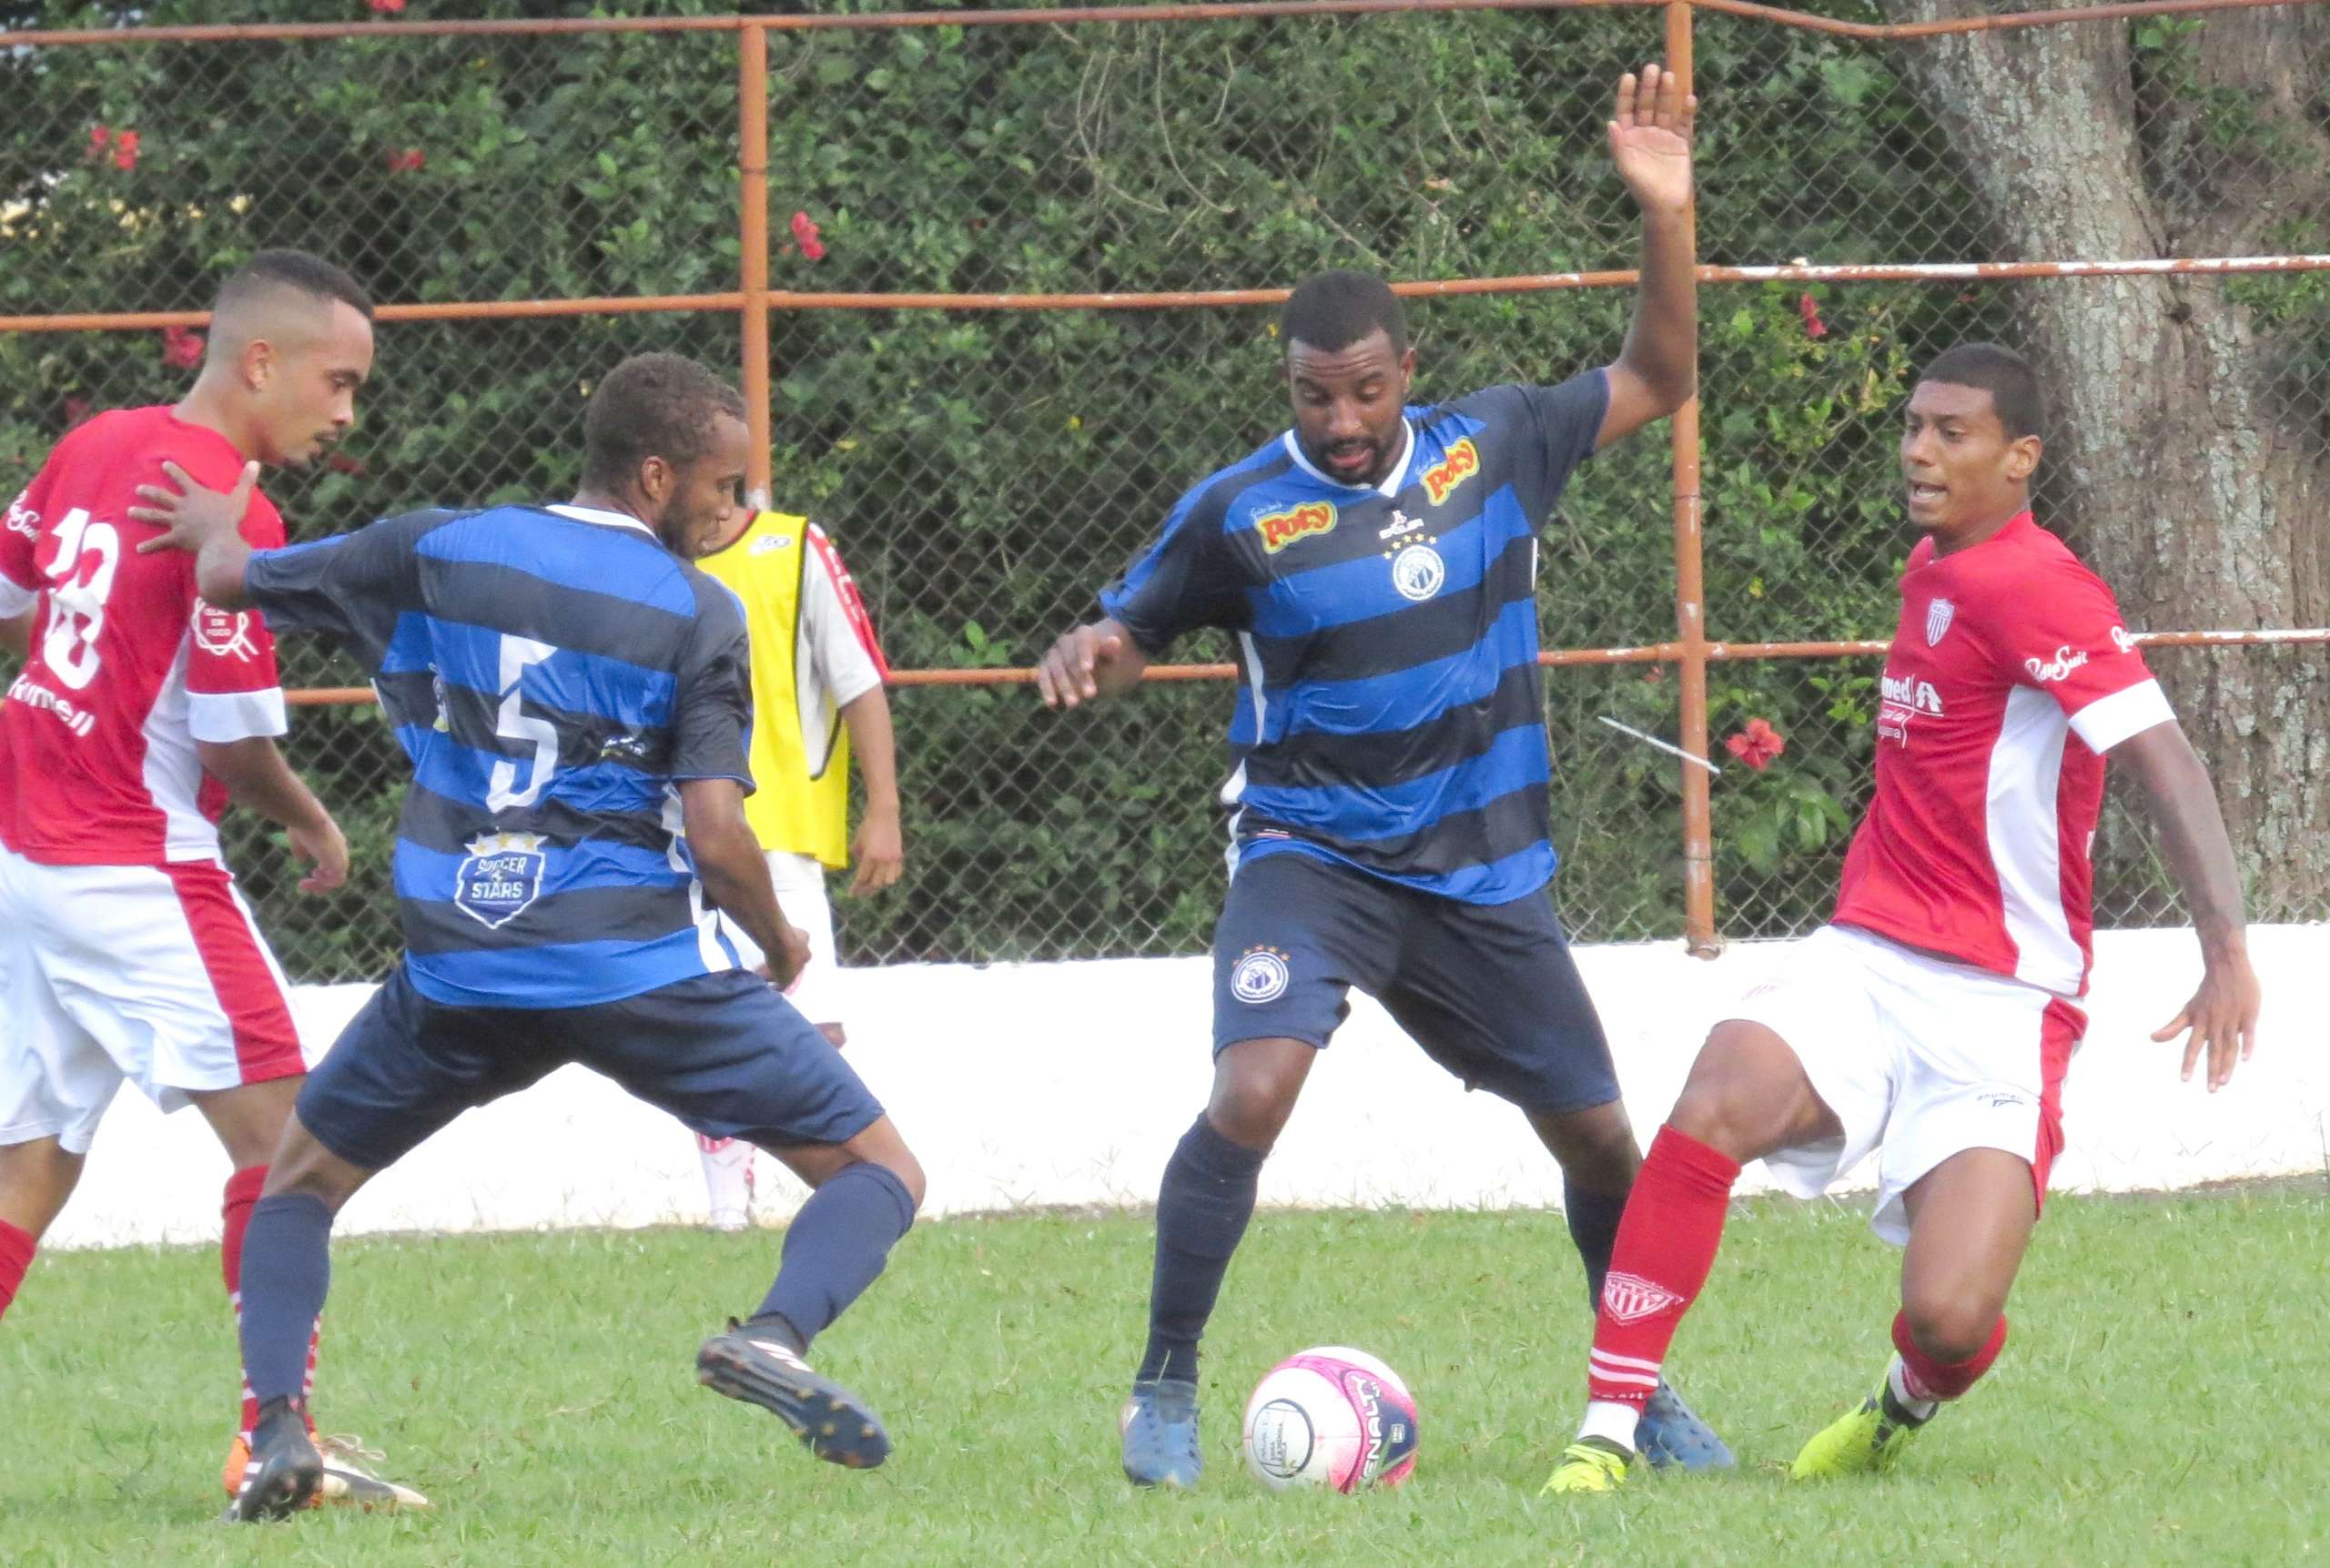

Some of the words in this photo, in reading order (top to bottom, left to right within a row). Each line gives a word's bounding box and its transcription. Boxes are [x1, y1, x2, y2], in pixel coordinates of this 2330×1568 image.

[485, 632, 559, 814] 5
[471, 881, 523, 899] STARS
[474, 856, 527, 876] SOCCER
[1351, 1375, 1382, 1479] ENALTY
